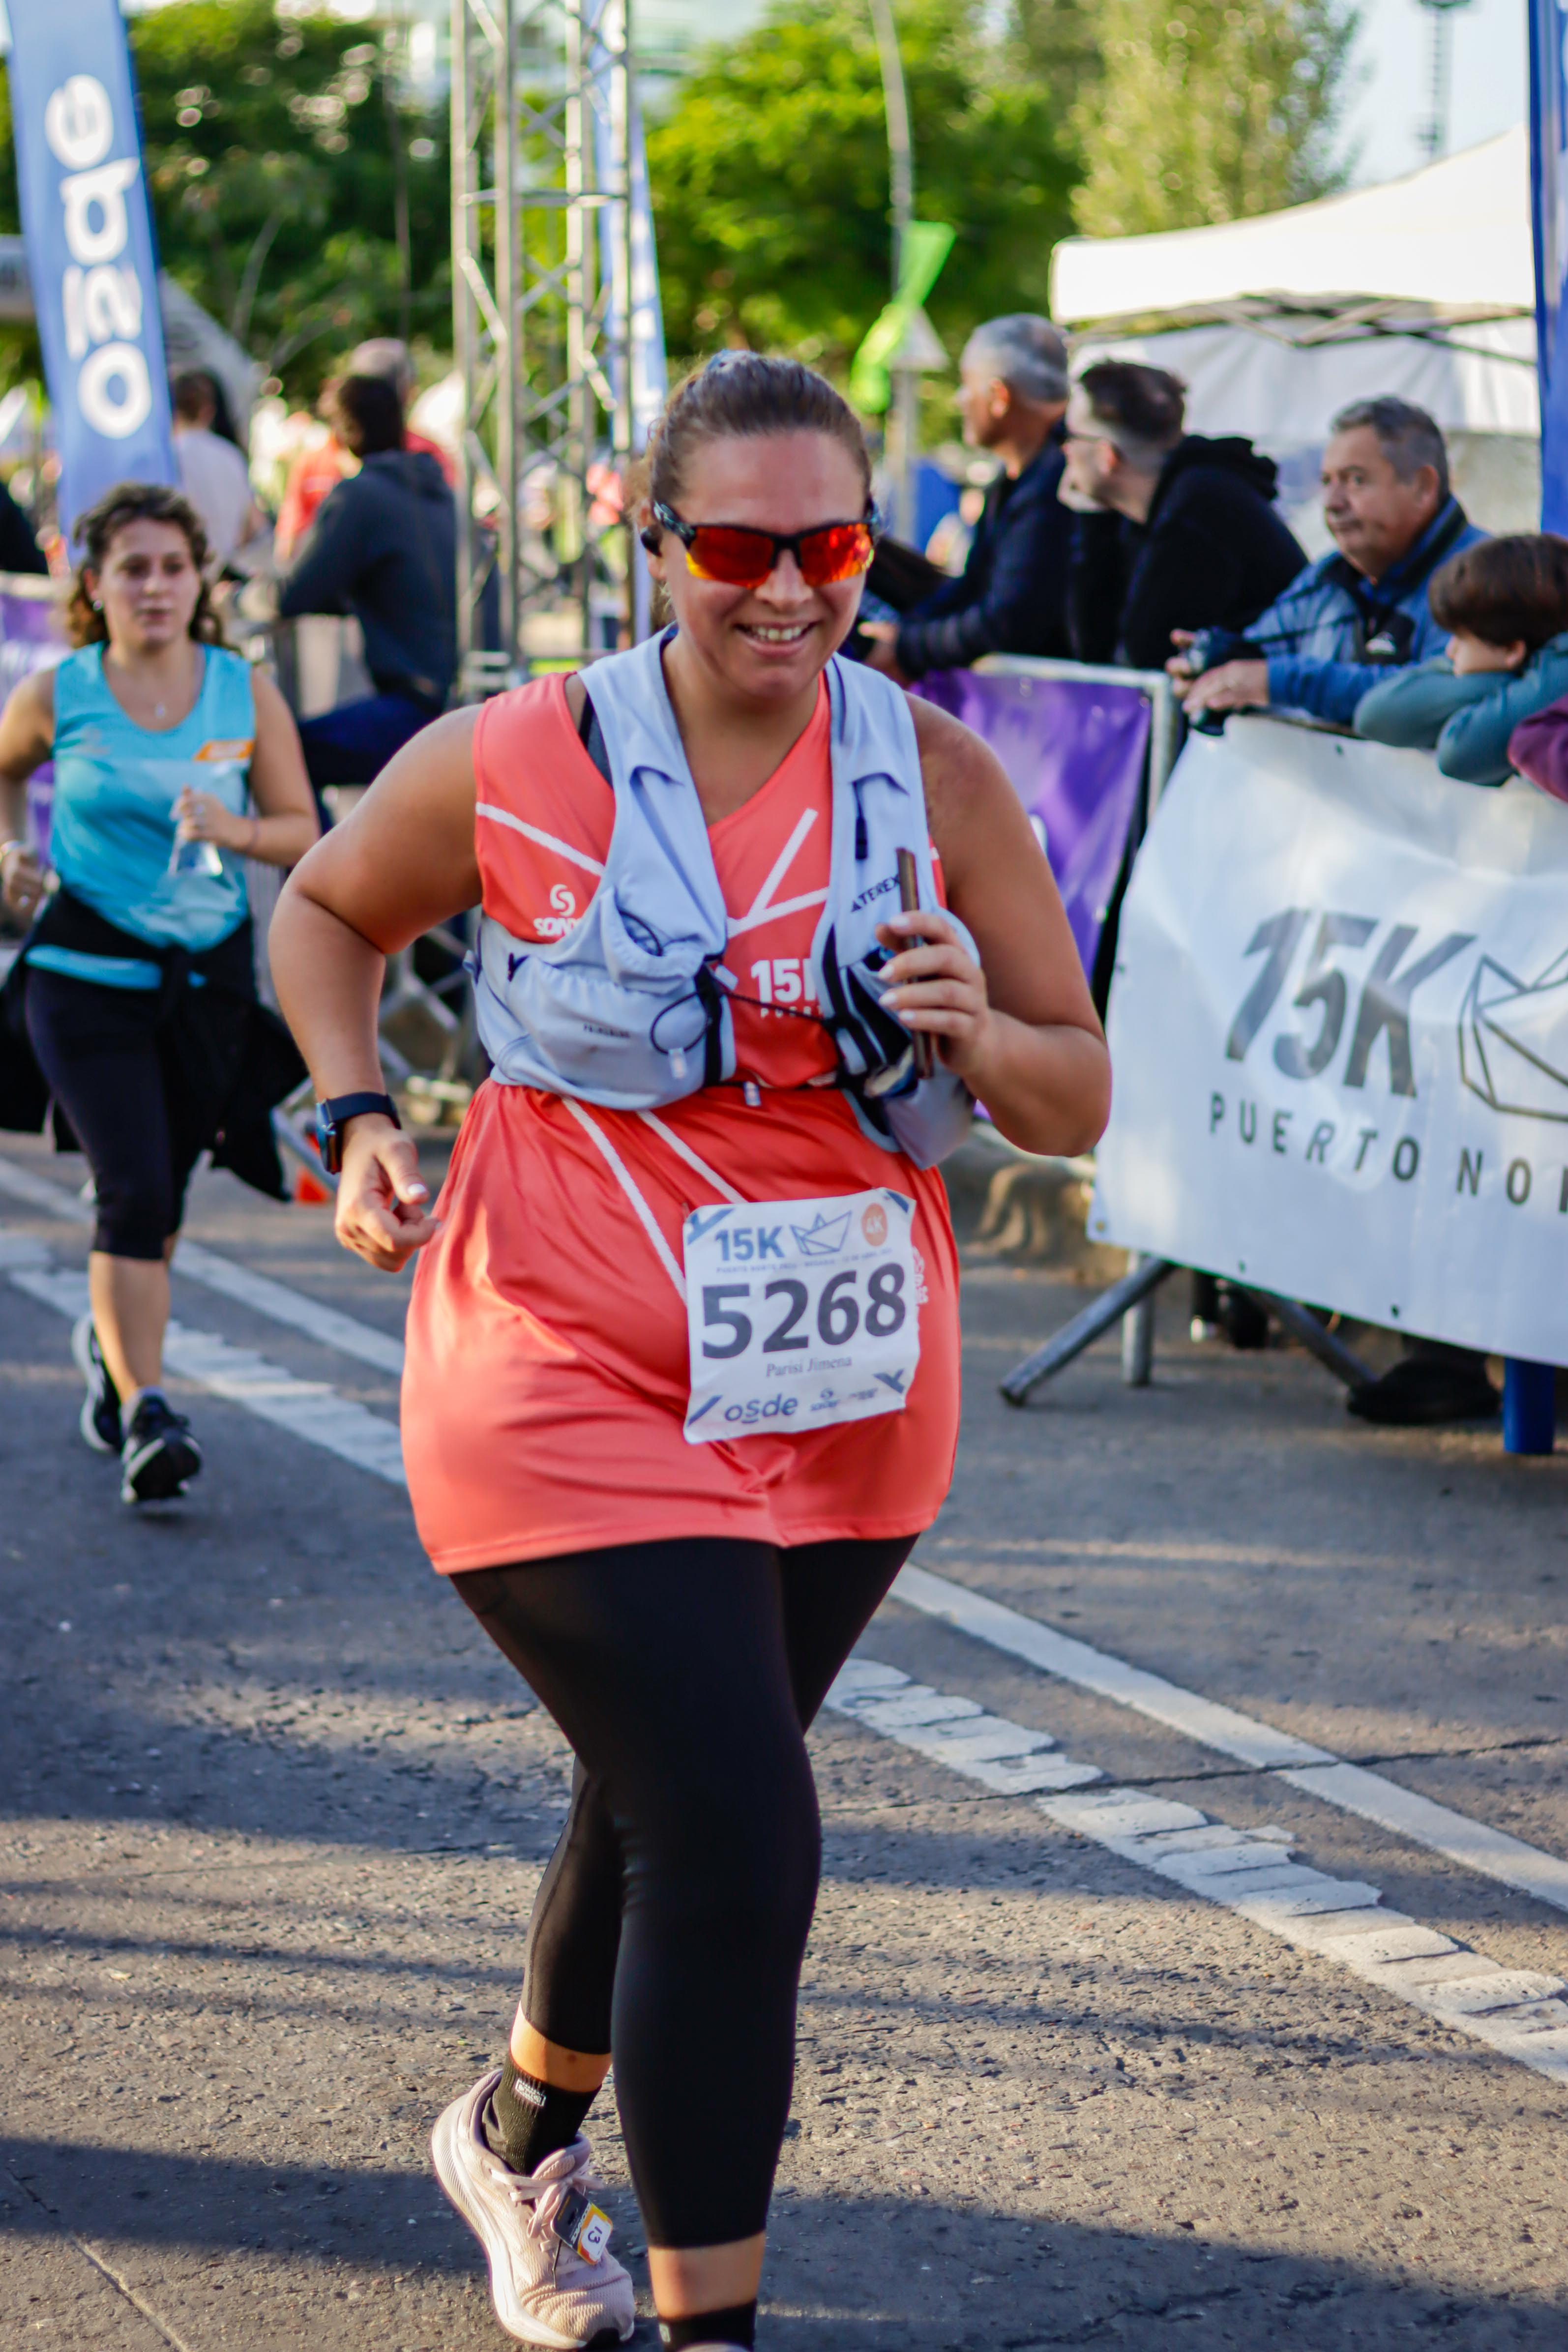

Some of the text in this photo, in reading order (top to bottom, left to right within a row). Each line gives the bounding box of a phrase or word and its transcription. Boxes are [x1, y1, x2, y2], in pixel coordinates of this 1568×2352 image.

[1226, 907, 1478, 1098] 15K
[1210, 1092, 1420, 1182] PUERTO
[715, 1225, 785, 1261] 15K
[702, 1262, 906, 1359] 5268
[767, 1356, 852, 1377] Parisi Jimena
[725, 1393, 798, 1423] osde
